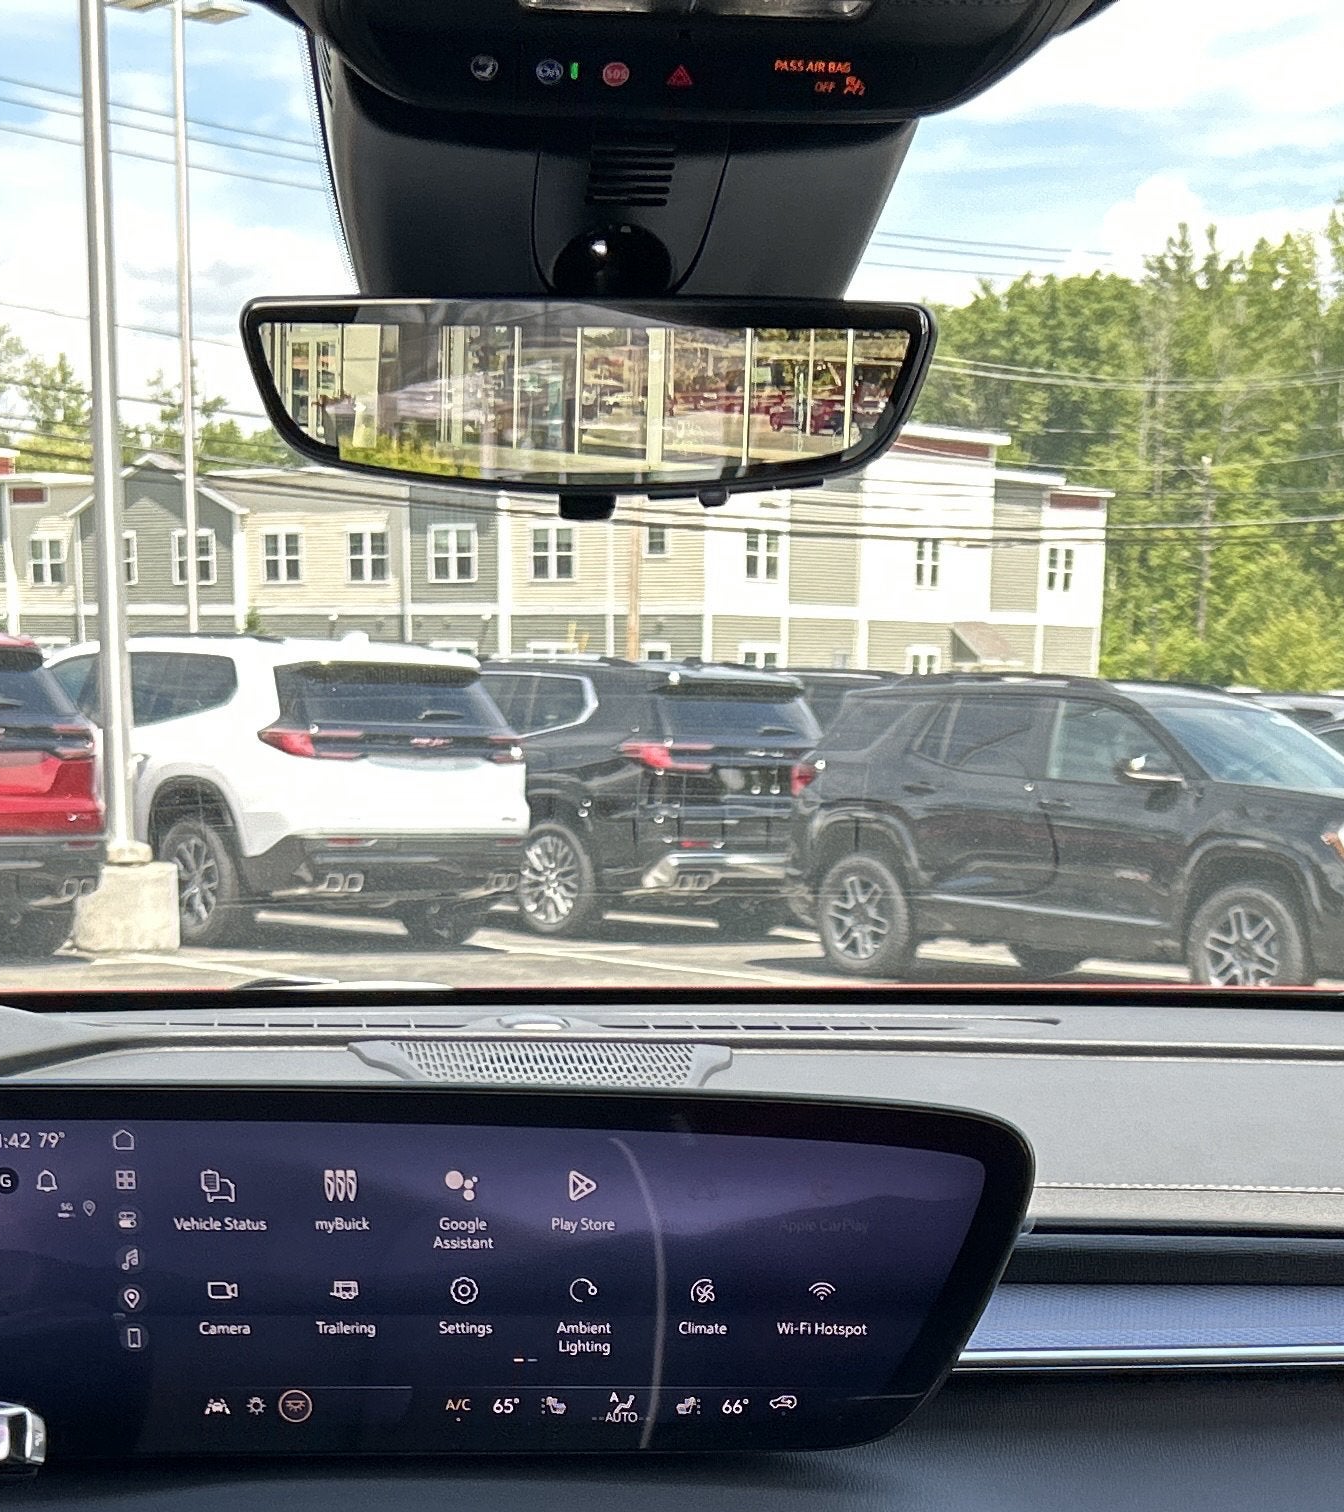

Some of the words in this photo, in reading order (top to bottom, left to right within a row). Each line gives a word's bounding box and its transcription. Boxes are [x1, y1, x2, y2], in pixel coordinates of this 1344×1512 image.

[774, 59, 804, 71] PASS
[806, 61, 826, 72] AIR
[828, 61, 851, 73] BAG
[607, 69, 626, 80] SOS
[814, 81, 836, 93] OFF
[38, 1131, 66, 1149] 79°
[173, 1217, 221, 1232] Vehicle
[224, 1217, 268, 1232] Status
[314, 1217, 370, 1234] myBuick
[439, 1217, 488, 1235] Google
[551, 1218, 579, 1235] Play
[581, 1218, 616, 1231] Store
[433, 1236, 494, 1251] Assistant
[199, 1321, 251, 1336] Camera
[316, 1321, 376, 1338] Trailering
[439, 1321, 493, 1337] Settings
[556, 1321, 612, 1336] Ambient
[678, 1321, 727, 1336] Climate
[776, 1321, 810, 1336] Wi-Fi
[814, 1321, 868, 1338] Hotspot
[558, 1339, 611, 1356] Lighting
[445, 1398, 472, 1411] A/C
[492, 1397, 520, 1414] 65°
[721, 1397, 750, 1414] 66°
[605, 1412, 638, 1423] AUTO
